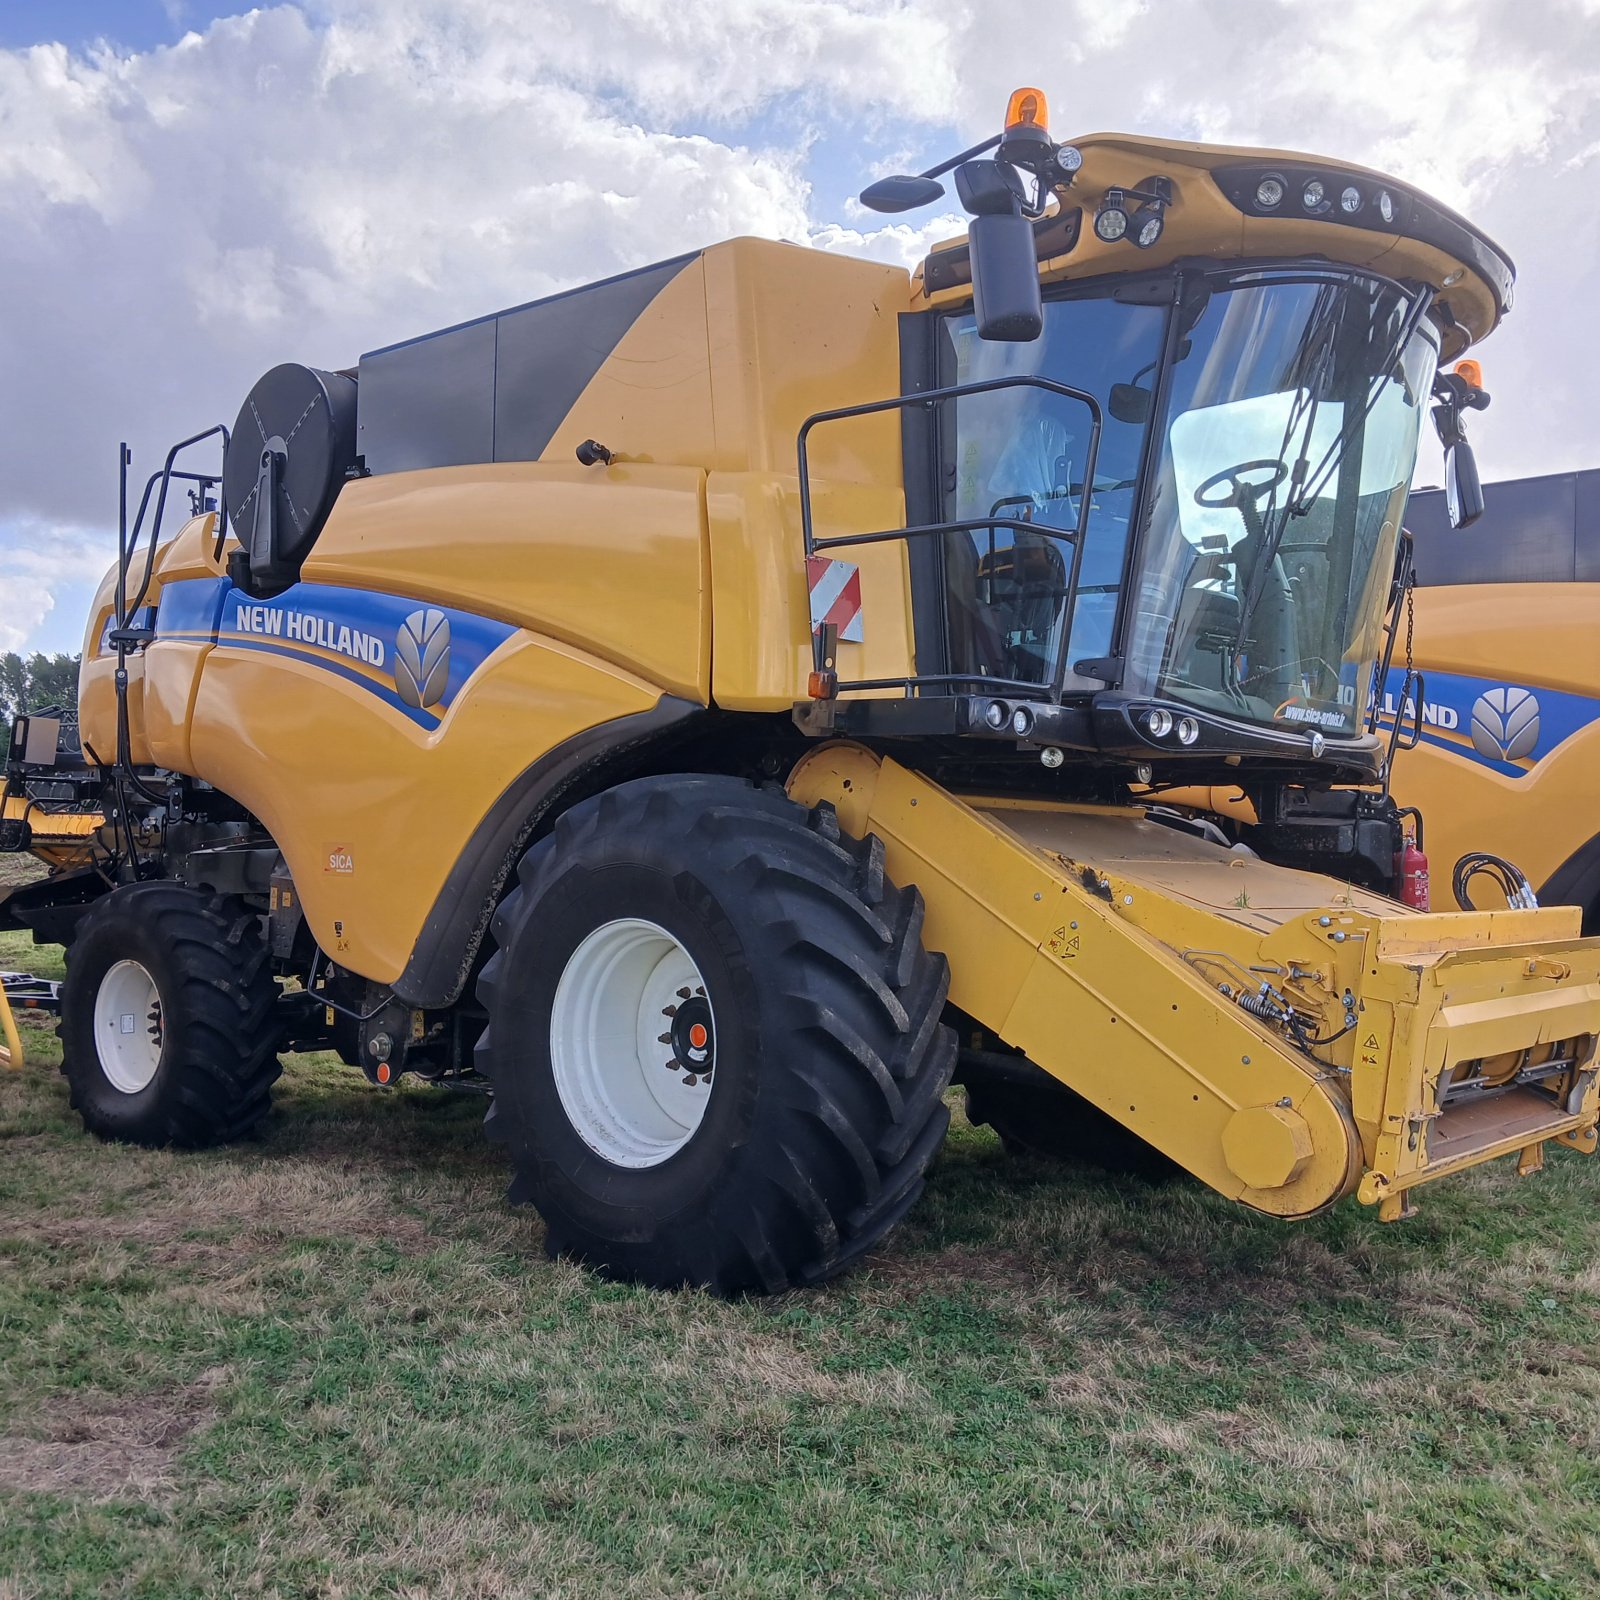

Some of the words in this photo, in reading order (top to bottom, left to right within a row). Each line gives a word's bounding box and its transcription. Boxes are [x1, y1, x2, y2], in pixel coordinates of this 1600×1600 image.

[236, 605, 283, 636] NEW
[286, 611, 385, 667] HOLLAND
[329, 853, 353, 869] SICA
